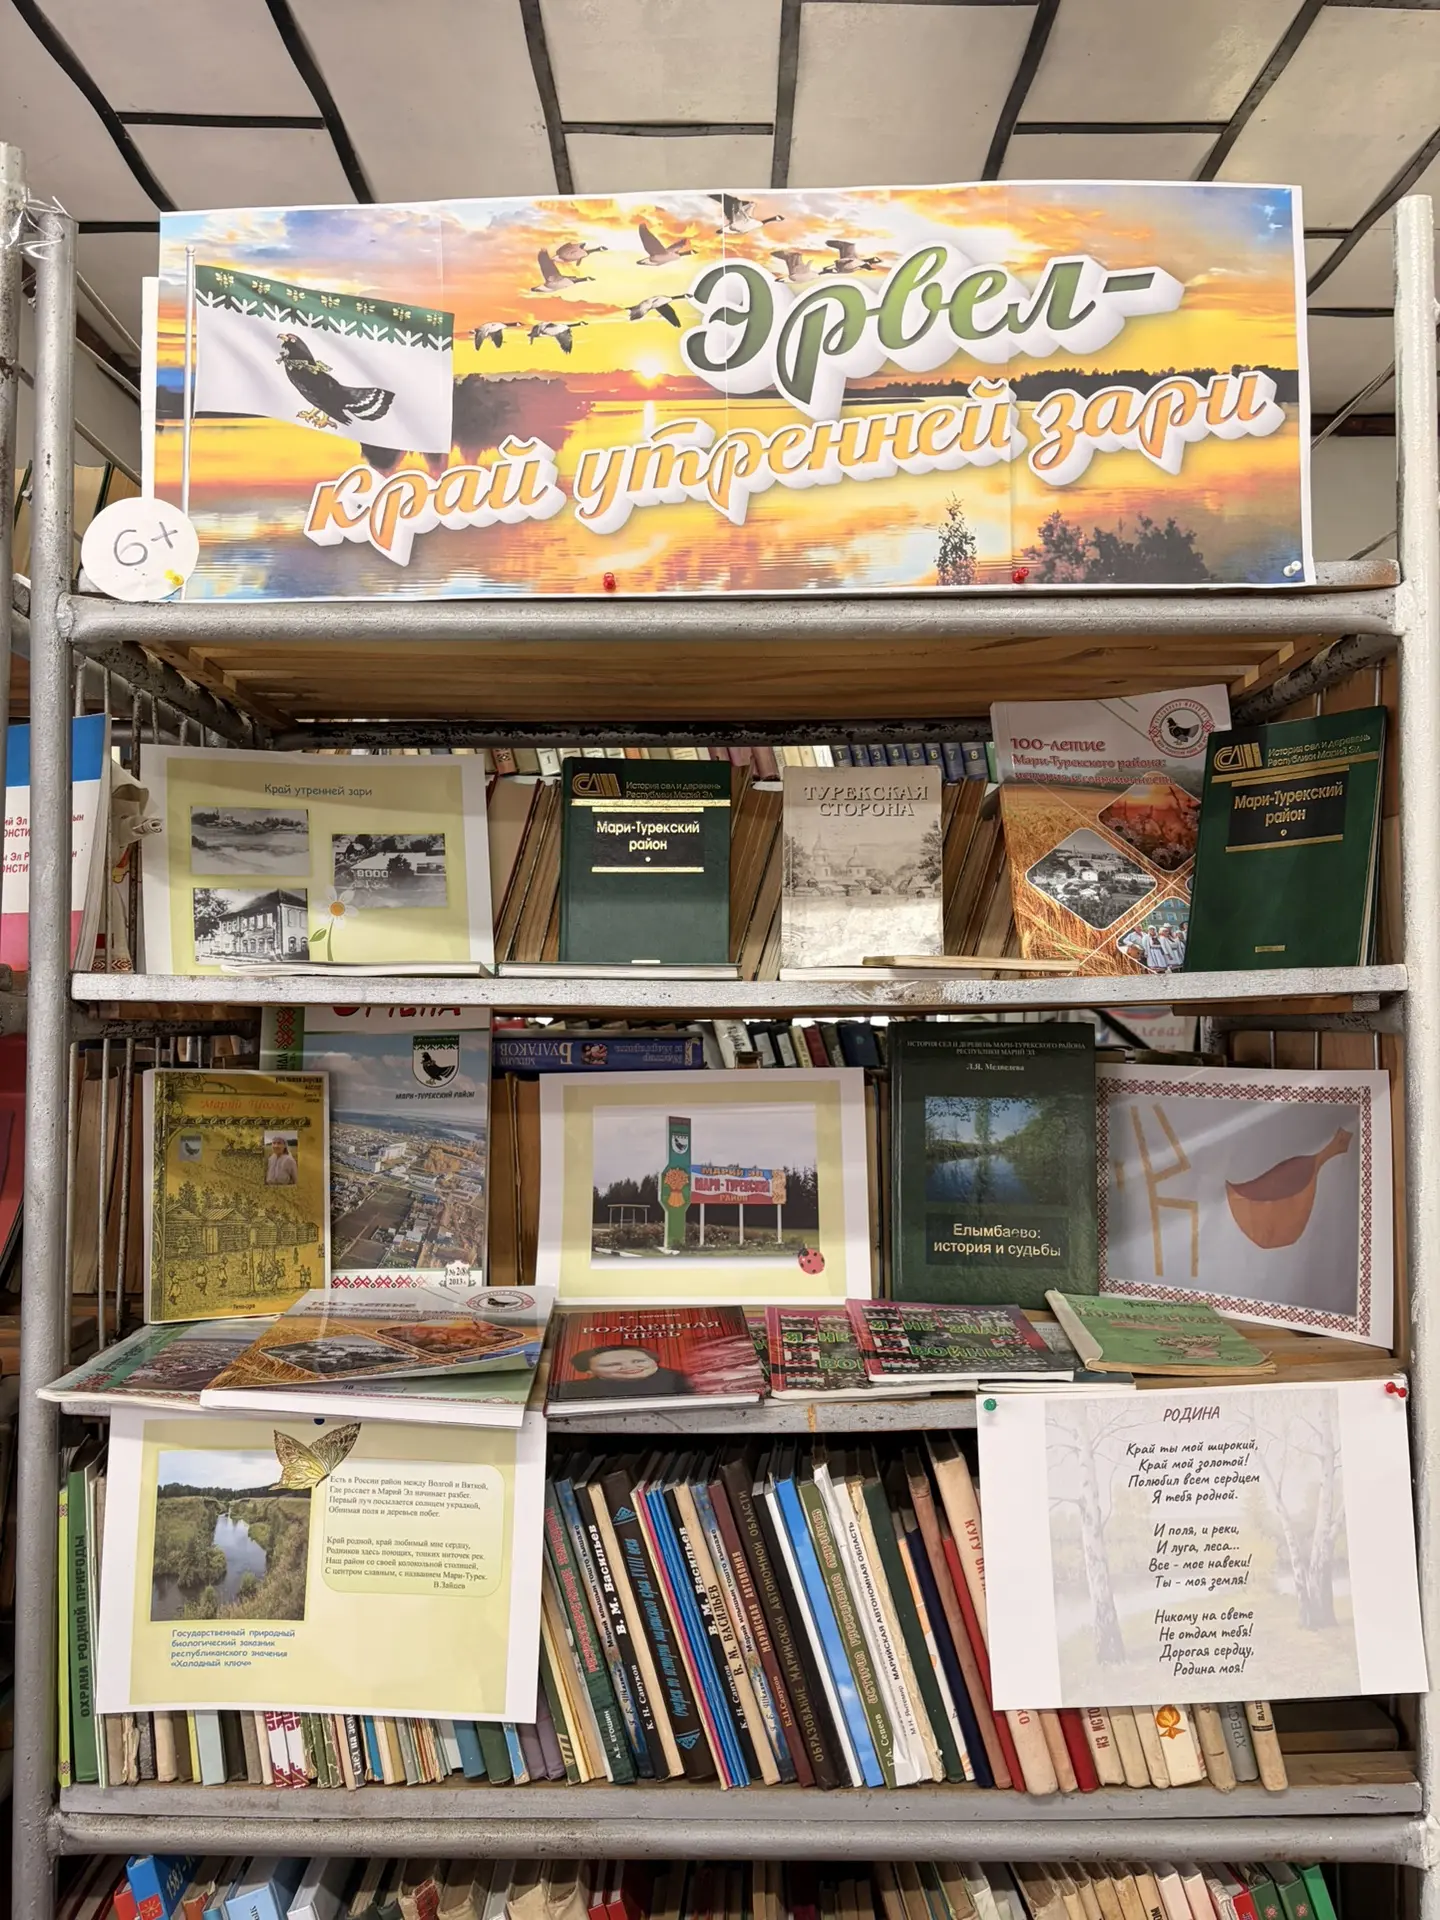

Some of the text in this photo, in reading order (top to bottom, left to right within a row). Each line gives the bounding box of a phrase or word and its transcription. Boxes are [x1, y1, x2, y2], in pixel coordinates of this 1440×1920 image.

[684, 244, 1157, 406] Эрвел-
[308, 374, 1269, 553] край утренней зари
[114, 520, 179, 567] 6+
[1010, 738, 1106, 752] 100-летие
[1012, 754, 1167, 773] Мари-Турекского района:
[264, 782, 373, 798] Край утренней зари
[804, 786, 929, 801] ТУРЕКСКАЯ
[1234, 781, 1344, 810] Мари-Турекский
[819, 802, 916, 817] СТОРОНА
[1265, 808, 1307, 827] район
[597, 821, 700, 836] Мари-Турекский
[629, 838, 667, 852] район
[500, 1042, 573, 1065] БУЛГАКОВ
[953, 1223, 1041, 1239] Елымбаево:
[934, 1242, 1061, 1257] история и судьбы
[623, 1331, 681, 1340] ПЕТЬ
[1163, 1406, 1220, 1423] РОДИНА
[1126, 1439, 1258, 1458] Край ты мой широкий,
[1139, 1453, 1249, 1474] Край мой золотой!
[330, 1476, 488, 1490] Есть России район между Волгой Вяткой,
[1128, 1471, 1260, 1488] Полюбил всем сердцем
[1152, 1488, 1238, 1505] Я тебя родной.
[736, 1488, 760, 1537] ОБЛАСТИ
[963, 1518, 982, 1551] КУГУ
[1154, 1523, 1239, 1538] И поля, и реки,
[326, 1536, 345, 1545] Край
[346, 1538, 373, 1547] родной,
[376, 1538, 392, 1547] край
[394, 1539, 428, 1548] любимый
[445, 1542, 471, 1550] сердцу,
[1156, 1540, 1168, 1554] И
[1171, 1544, 1198, 1556] луга,
[1149, 1554, 1252, 1572] Все мое навеки!
[433, 1581, 466, 1590] В.Зайцев
[572, 1523, 616, 1648] Марий илышын тошто кышаже
[585, 1523, 626, 1636] В. М. Васильев
[678, 1525, 718, 1637] В. М. Васильев
[1155, 1571, 1249, 1591] Ты моя земля!
[731, 1549, 771, 1653] МАРИЙСКАЯ АВТОНОМИЯ
[809, 1506, 879, 1705] ИСТОРИЯ РАССЕЛЕНИЯ МАРИЙЦЕВ
[846, 1520, 901, 1681] МАРИЙСКАЯ АВТОНОМНАЯ ОБЛАСТЬ
[1154, 1607, 1253, 1625] Никому на свете
[73, 1534, 90, 1717] ОХРАНА РОДНОЙ ПРИРОДЫ
[172, 1629, 295, 1638] Государственный природный
[707, 1583, 744, 1676] В. М. ВАСИЛЬЕВ
[1159, 1623, 1253, 1642] Не отдам тебя!
[172, 1638, 236, 1647] биологический
[171, 1649, 247, 1659] республиканского
[1159, 1643, 1254, 1662] Дорогая сердцу,
[171, 1659, 220, 1668] «Холодный
[1174, 1659, 1246, 1677] Родина моя!
[629, 1663, 655, 1731] К. Н. Сануков
[793, 1684, 827, 1763] ОБРАЗОВАНИЕ
[602, 1709, 623, 1760] А.Е. ЕГОШИН
[1097, 1736, 1110, 1749] ИЗ
